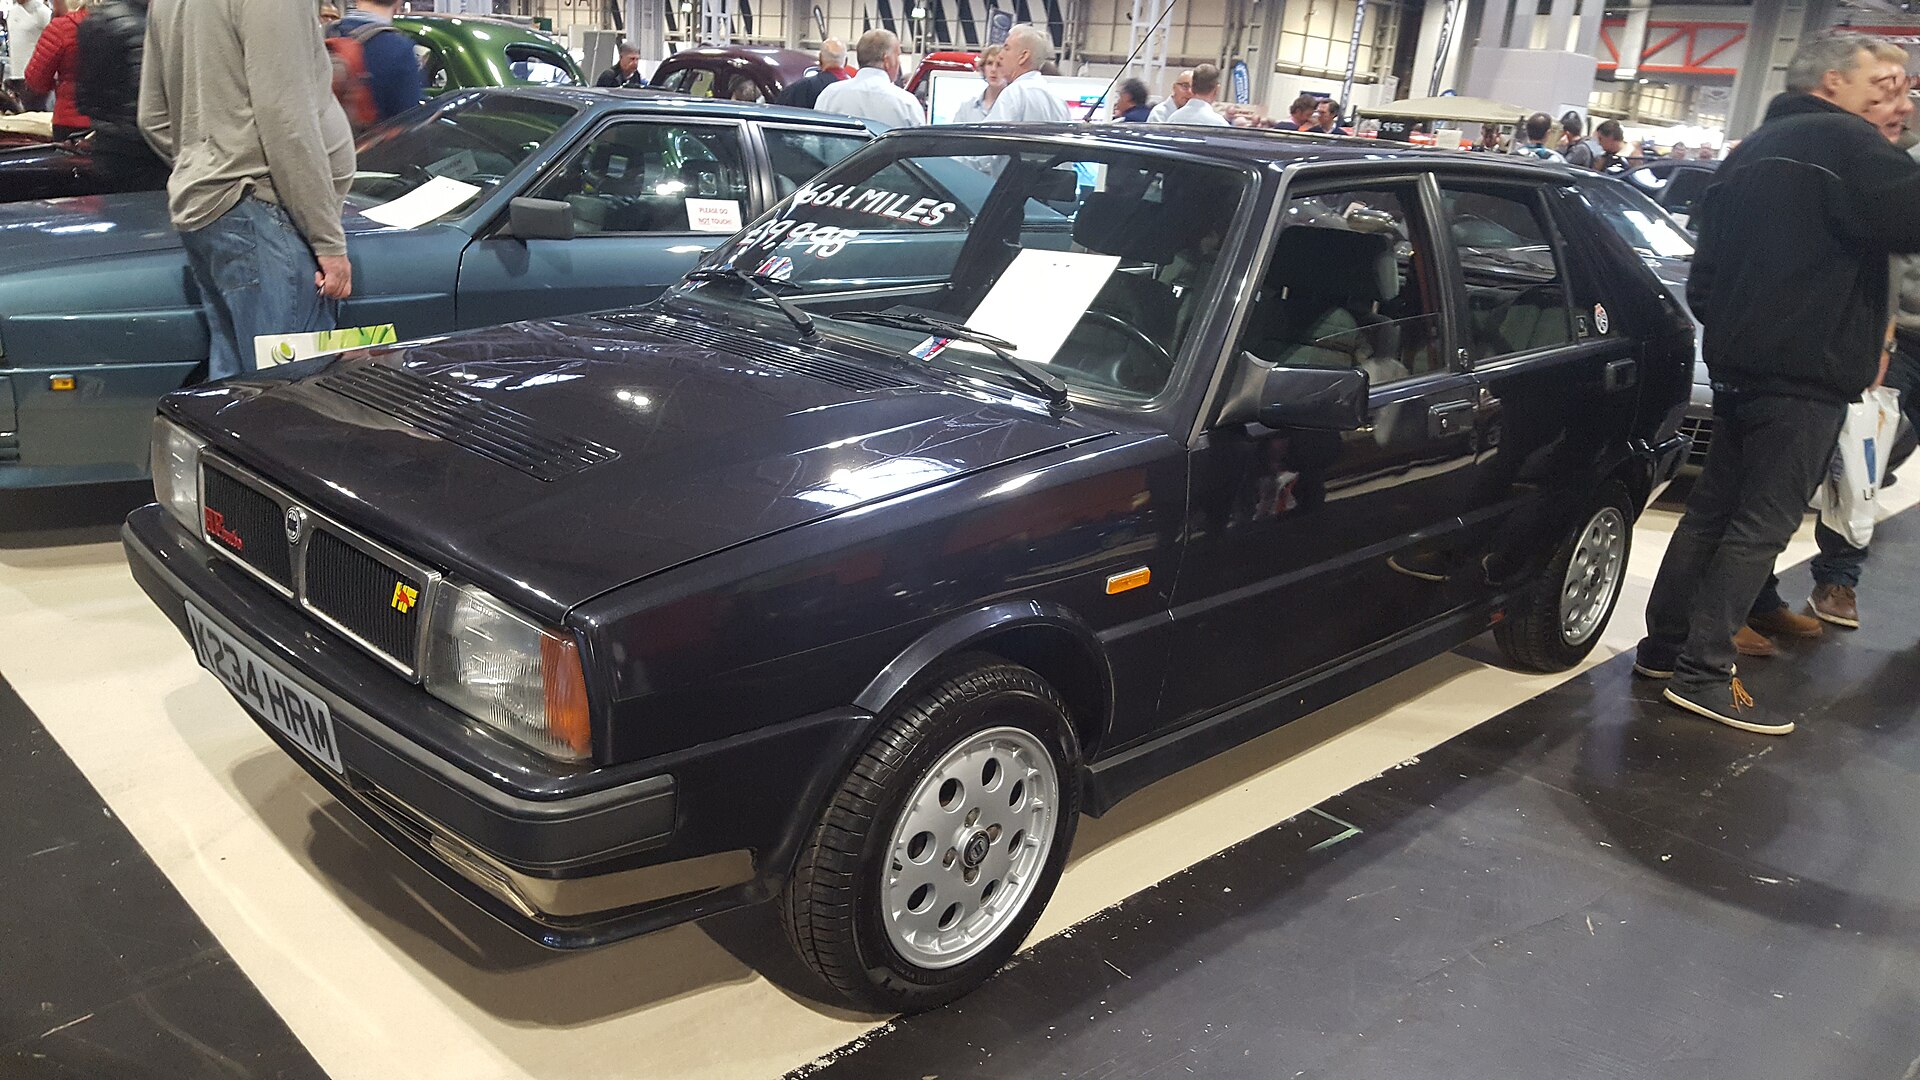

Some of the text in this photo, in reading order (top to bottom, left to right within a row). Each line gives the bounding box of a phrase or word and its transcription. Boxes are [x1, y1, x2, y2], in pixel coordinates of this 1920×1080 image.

[698, 217, 709, 225] NOT
[846, 188, 957, 227] MILES
[191, 613, 336, 763] K234 HRM
